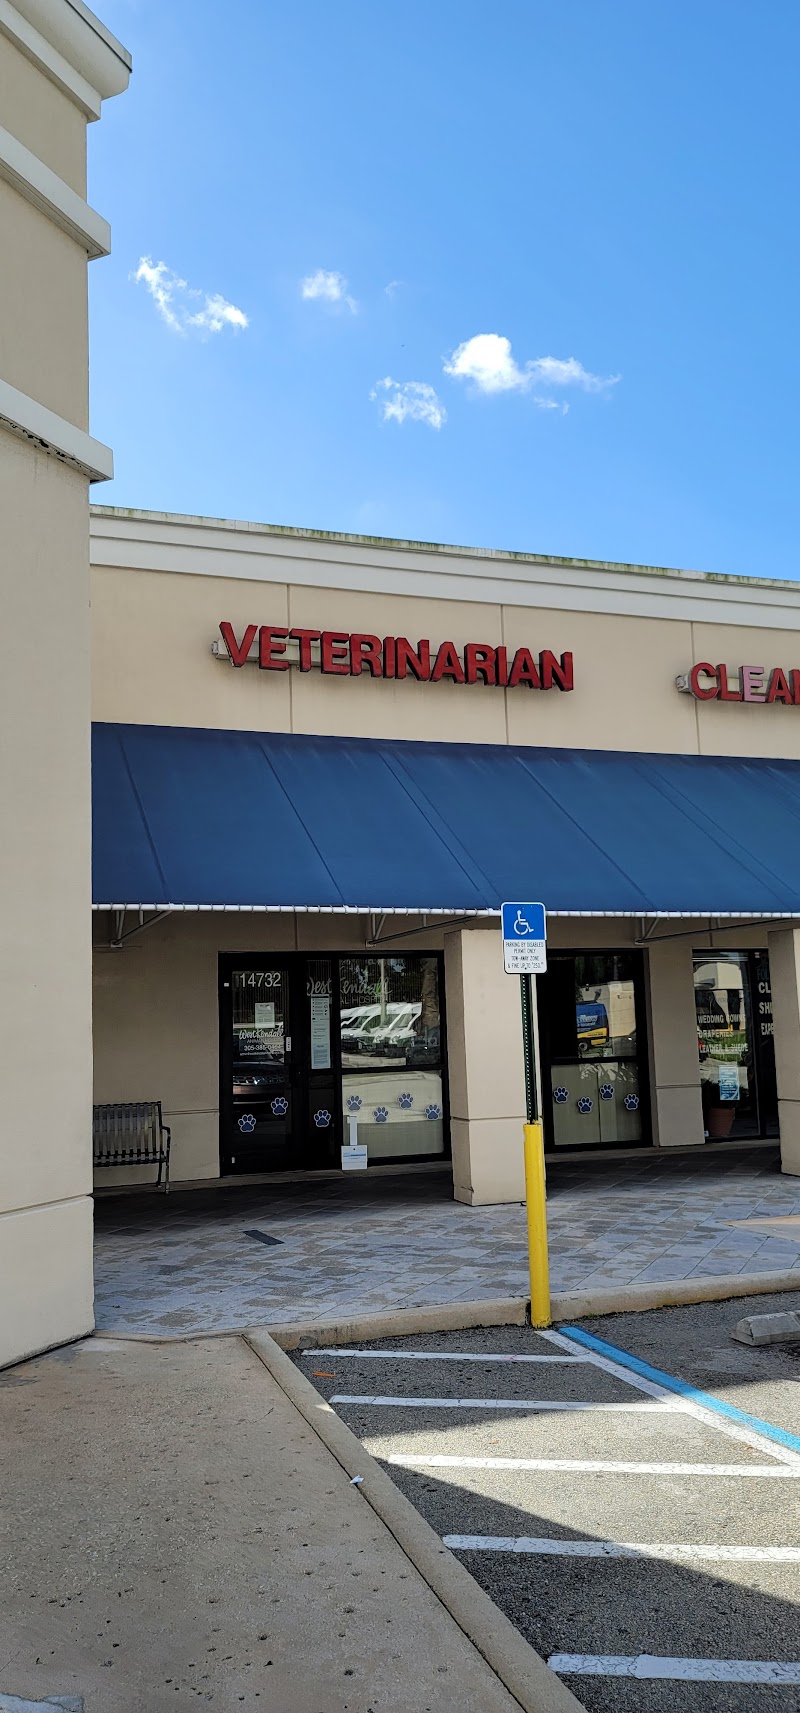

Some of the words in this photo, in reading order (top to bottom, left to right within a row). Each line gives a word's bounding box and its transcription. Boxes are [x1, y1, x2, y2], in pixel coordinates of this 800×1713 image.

[219, 622, 575, 692] VETERINARIAN
[239, 972, 282, 988] 14732
[758, 982, 771, 993] CL
[698, 1014, 724, 1023] WEDDING
[698, 1029, 733, 1038] DRAPERIES
